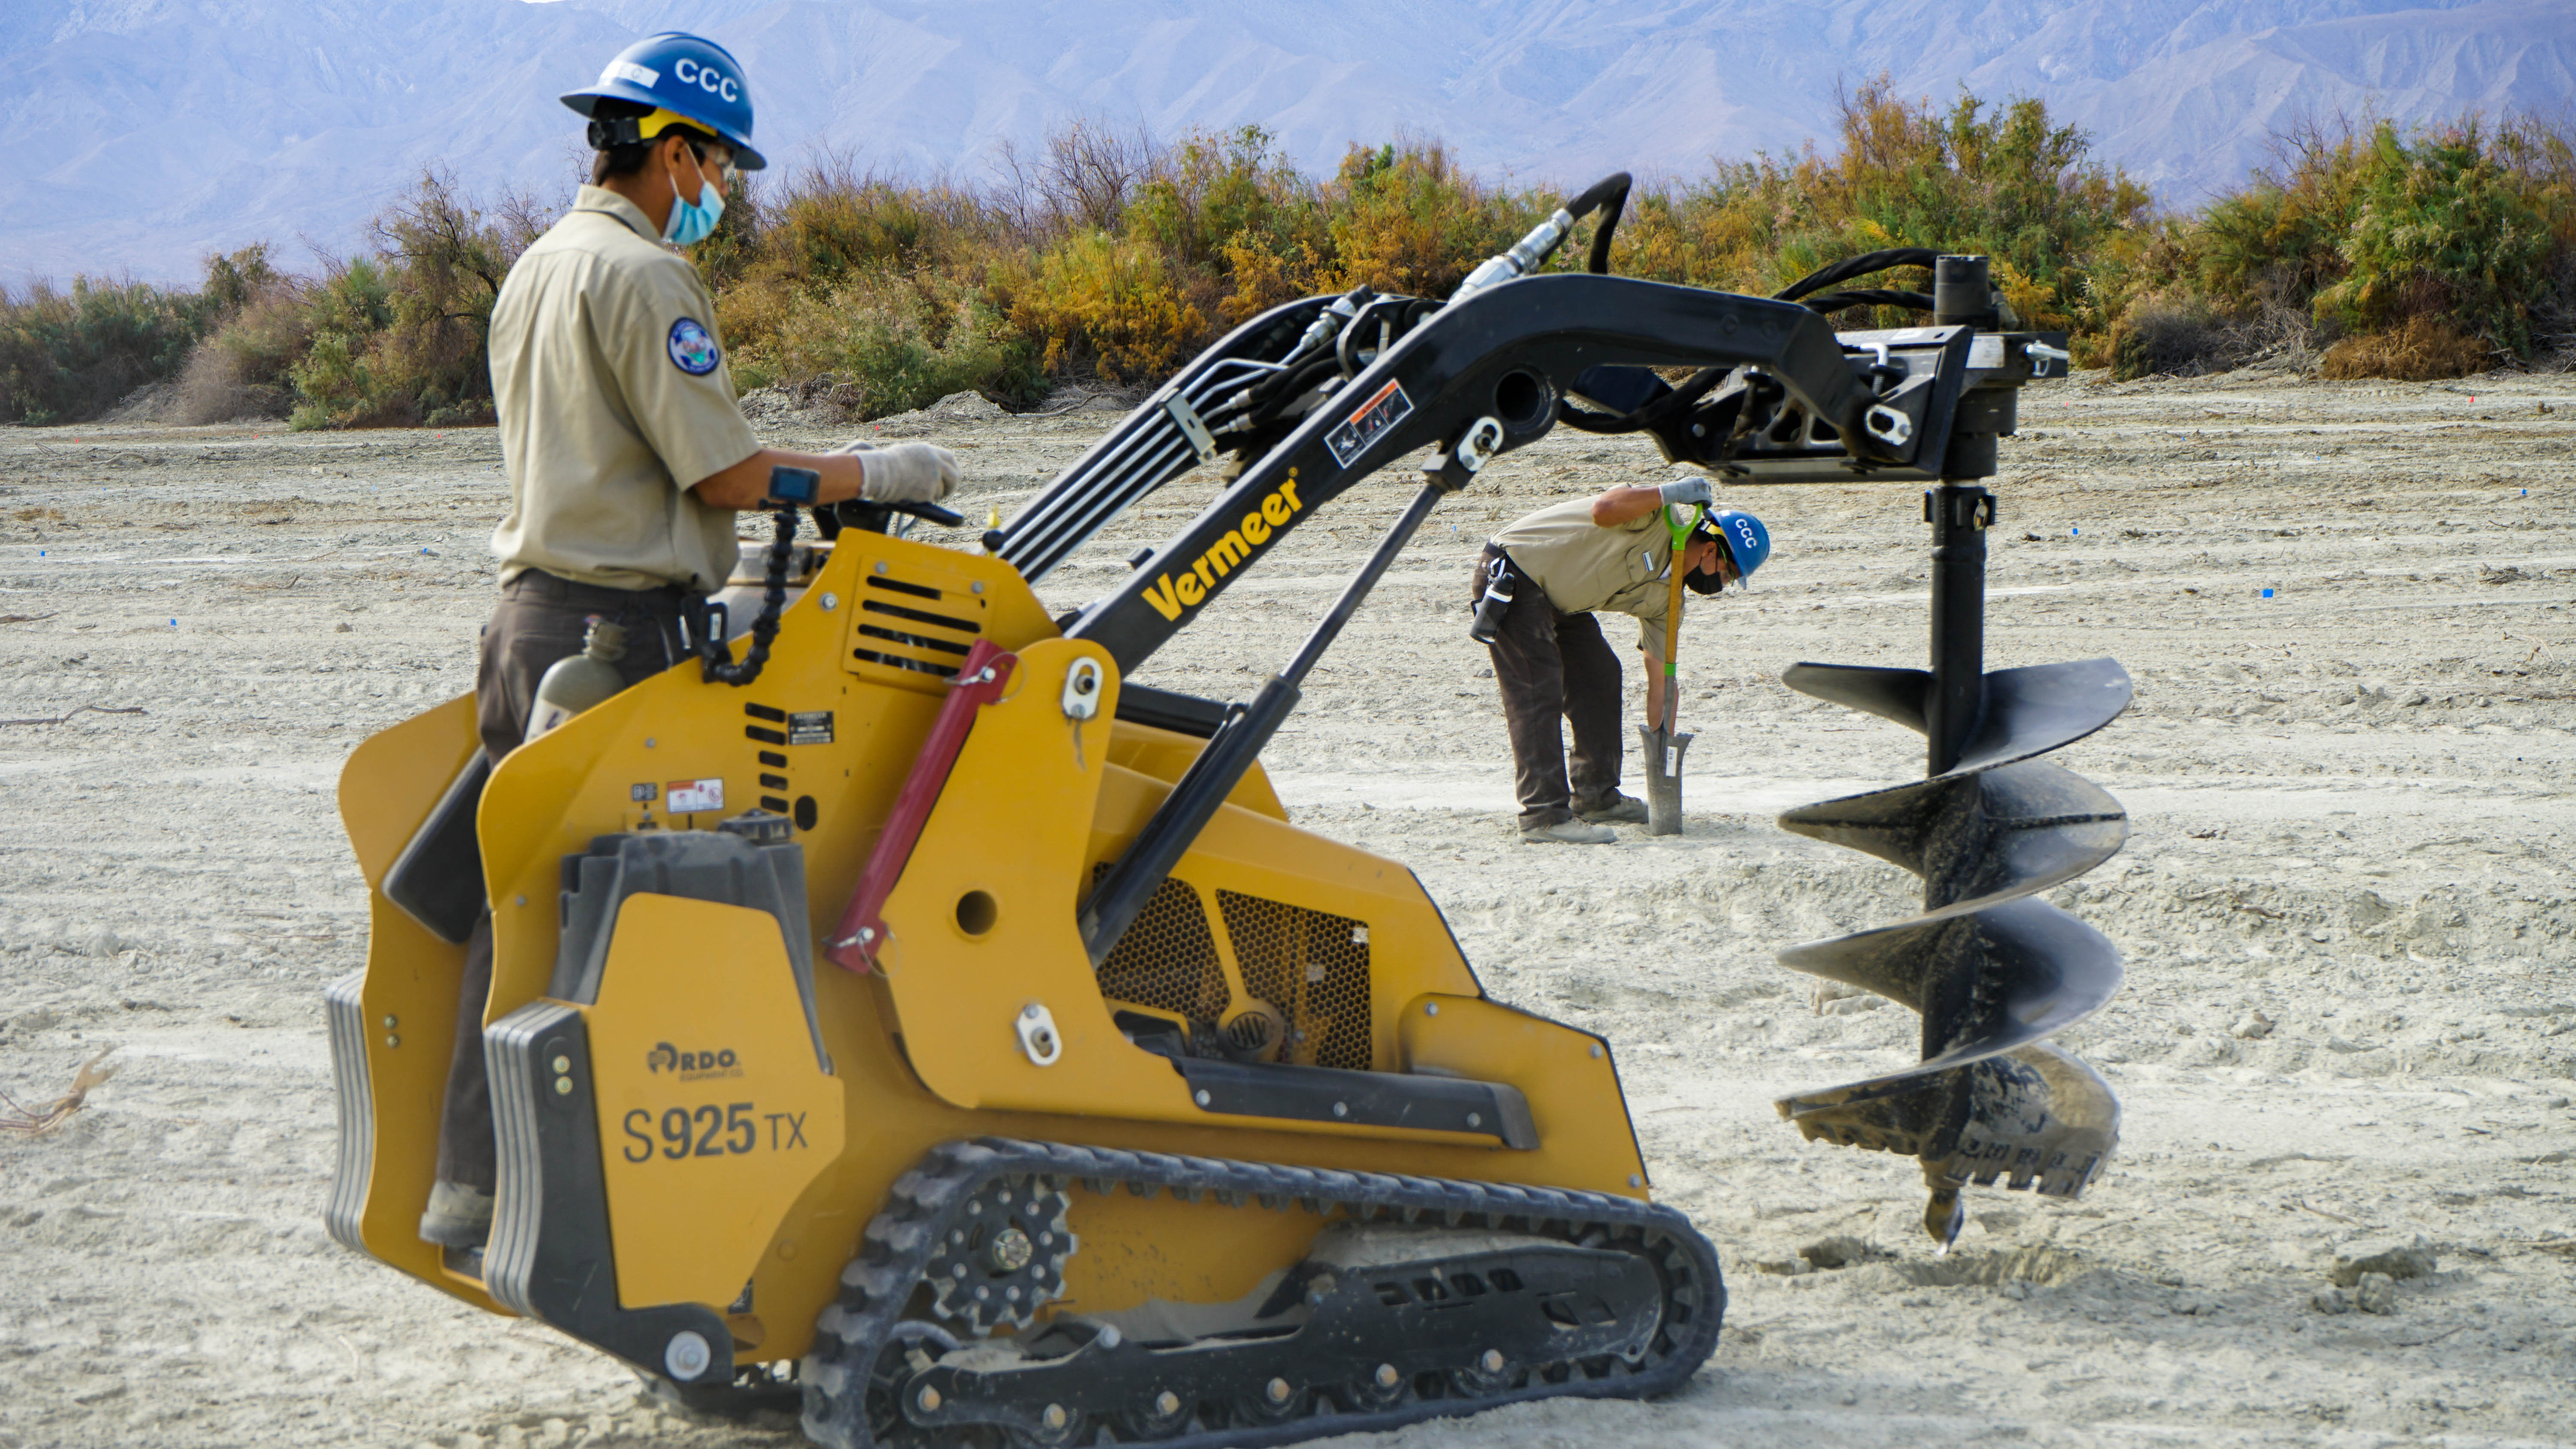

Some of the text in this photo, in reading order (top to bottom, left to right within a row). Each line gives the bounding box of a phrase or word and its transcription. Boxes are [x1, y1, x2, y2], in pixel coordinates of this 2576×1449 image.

[675, 58, 738, 103] CCC
[1141, 478, 1303, 622] Vermeer
[1735, 519, 1757, 549] CCC
[764, 1111, 808, 1151] TX
